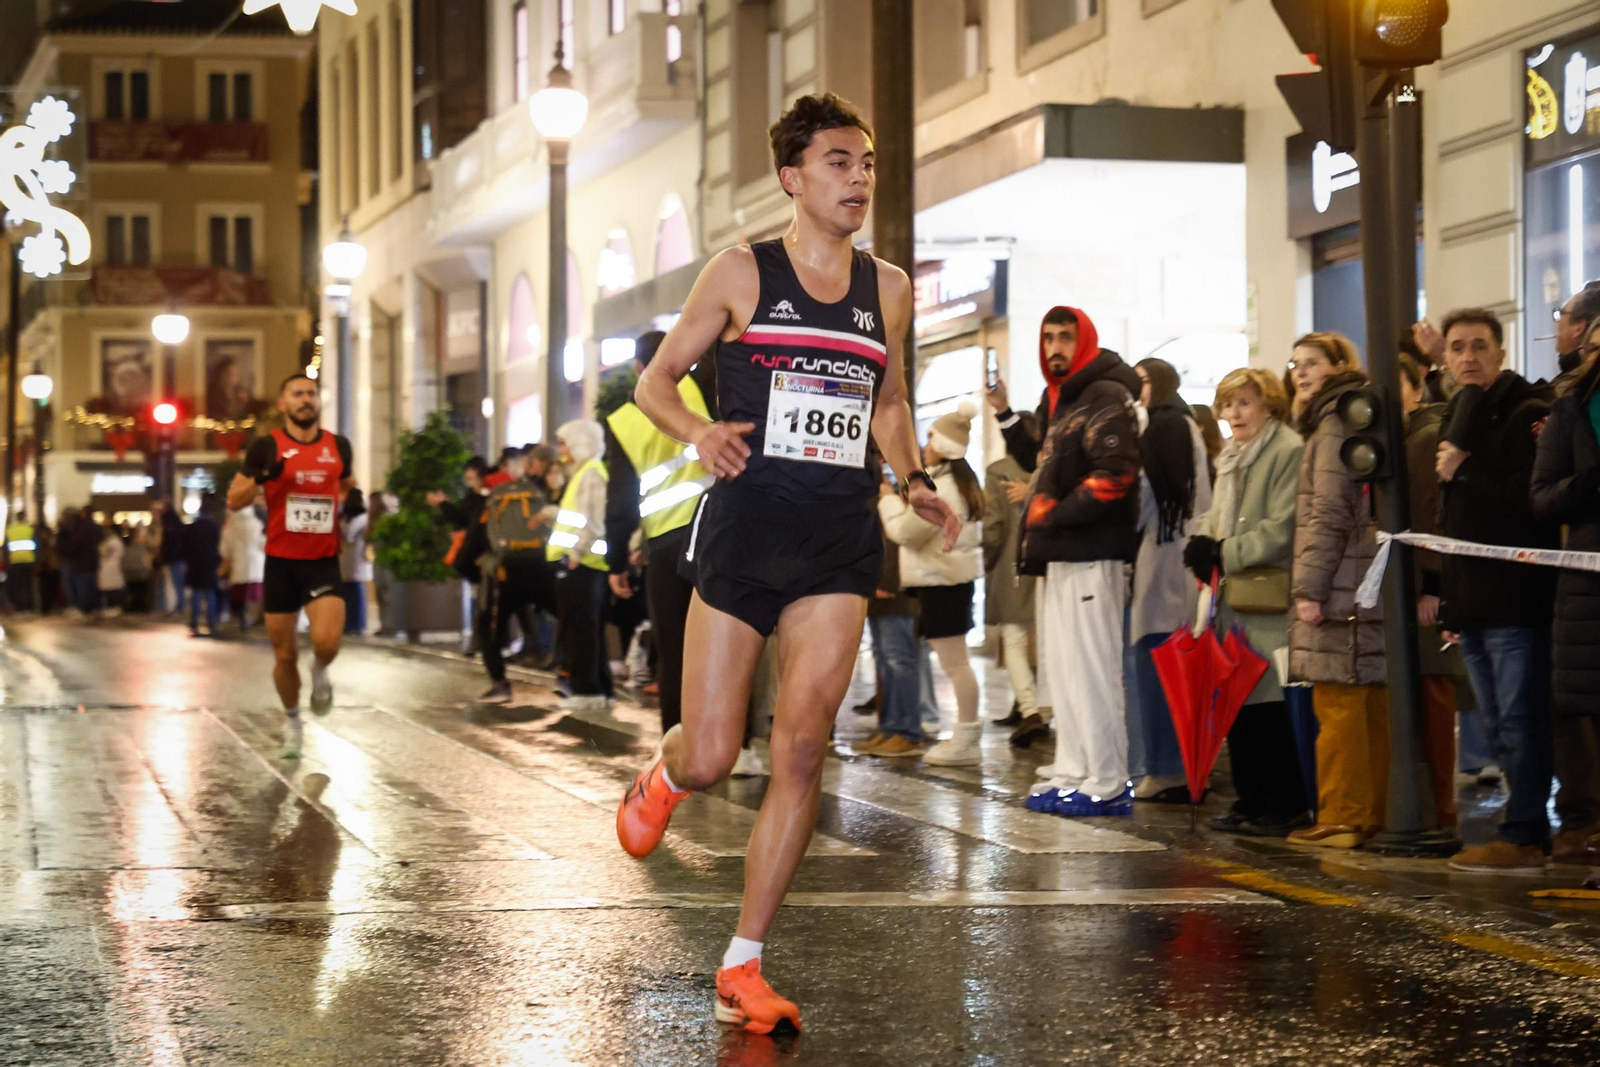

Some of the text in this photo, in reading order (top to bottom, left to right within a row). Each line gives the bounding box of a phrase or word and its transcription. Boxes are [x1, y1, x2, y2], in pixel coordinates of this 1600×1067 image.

[787, 383, 825, 394] NOCTURNA
[784, 407, 861, 440] 1866
[294, 510, 329, 521] 1347
